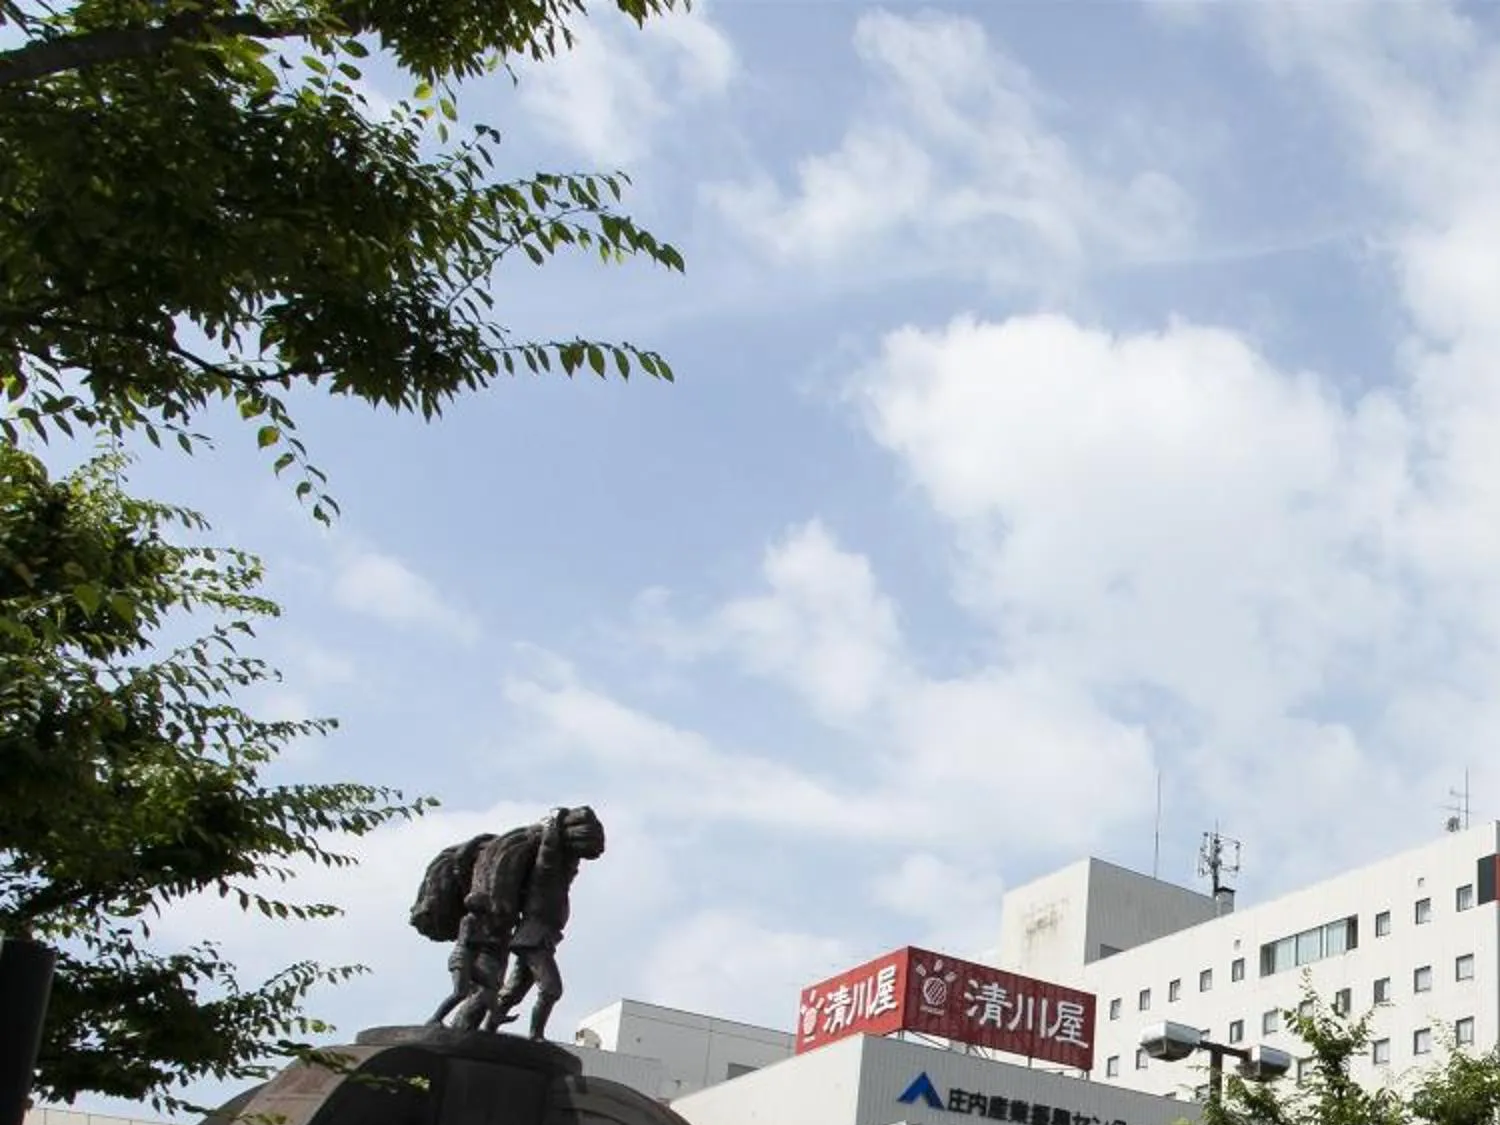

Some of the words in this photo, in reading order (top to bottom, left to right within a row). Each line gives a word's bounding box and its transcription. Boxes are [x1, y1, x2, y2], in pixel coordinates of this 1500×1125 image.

[823, 964, 898, 1034] 清川屋
[963, 979, 1089, 1049] 清川屋
